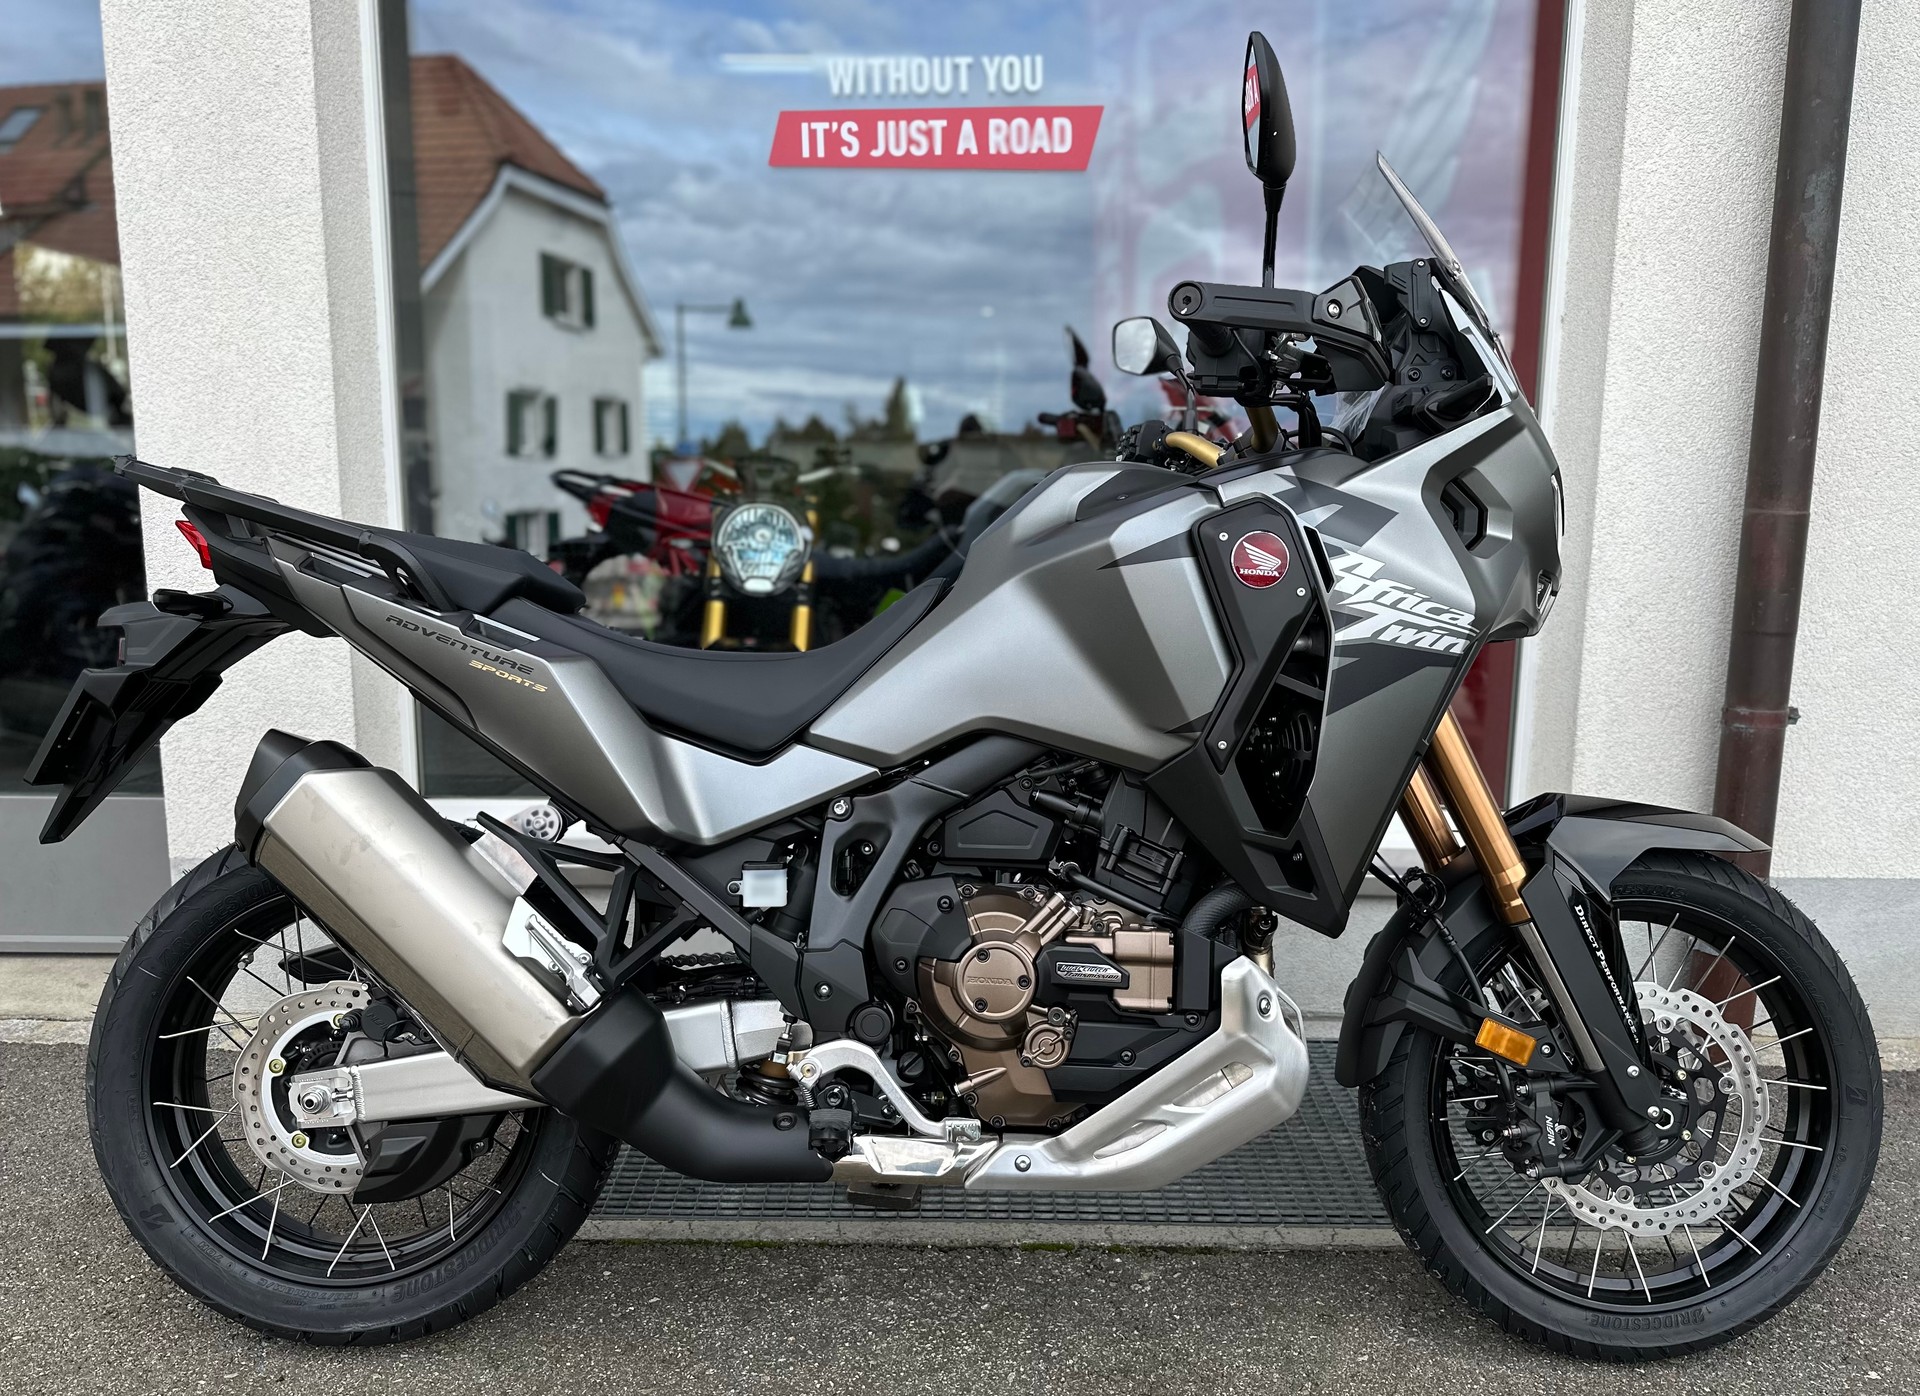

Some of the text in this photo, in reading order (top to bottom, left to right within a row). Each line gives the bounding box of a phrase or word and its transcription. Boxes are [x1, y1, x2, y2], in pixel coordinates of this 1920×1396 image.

[827, 55, 1043, 95] WITHOUT YOU
[801, 117, 1072, 158] IT'S JUST A ROAD
[1239, 568, 1280, 577] HONDA
[1330, 549, 1477, 627] Africa
[385, 614, 535, 675] ADVENTURE
[1334, 602, 1479, 653] Twin
[468, 659, 548, 693] SPORTS
[1574, 904, 1599, 949] DIRECT
[966, 975, 1015, 986] HONDA
[1064, 971, 1119, 980] Transmission
[1589, 1308, 1706, 1331] BRIDGESTONE
